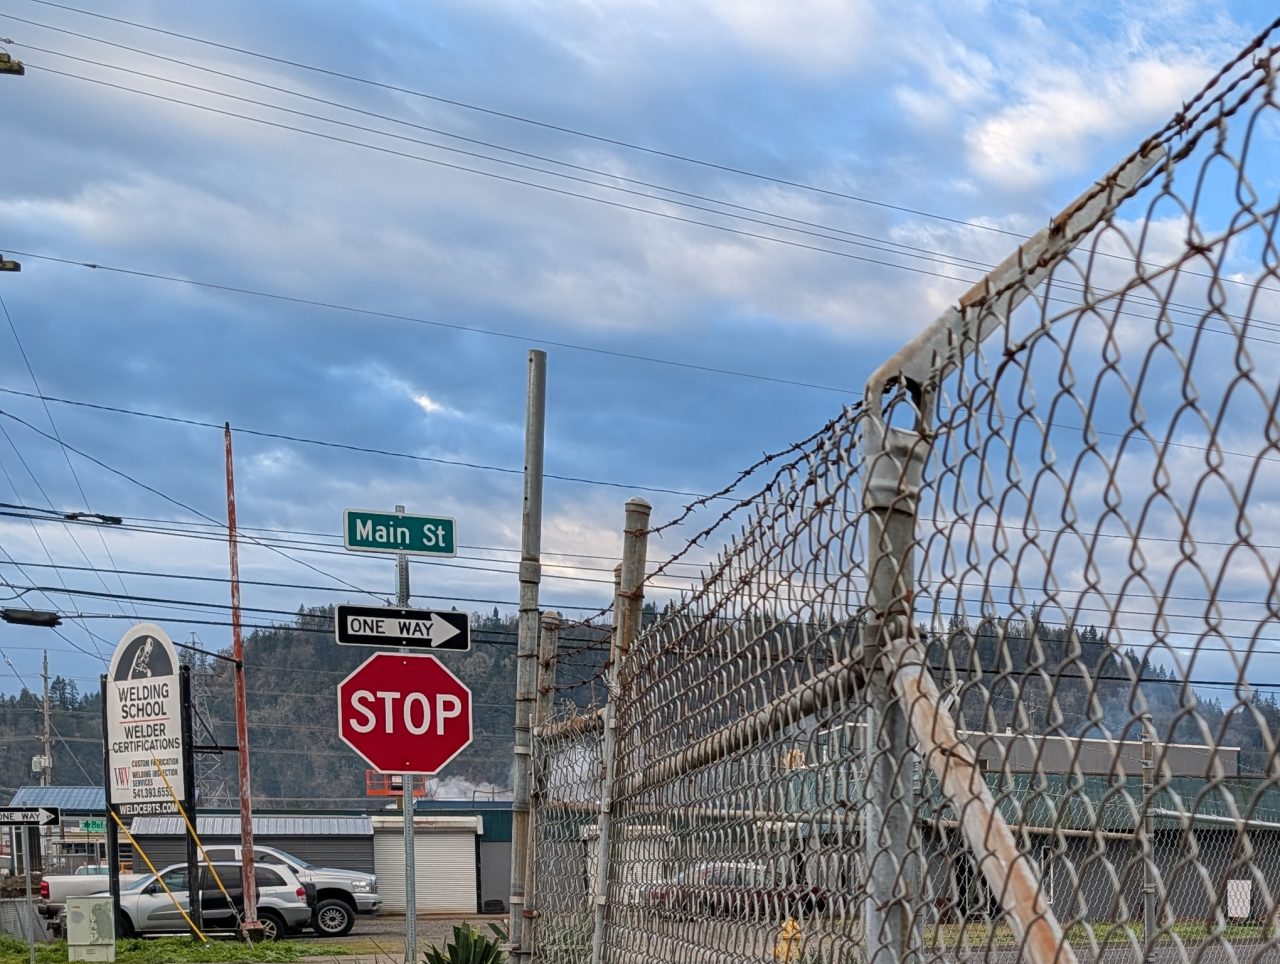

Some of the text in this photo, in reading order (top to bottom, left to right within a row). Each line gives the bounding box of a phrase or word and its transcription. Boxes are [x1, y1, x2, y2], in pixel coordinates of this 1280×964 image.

[356, 519, 446, 547] Main St
[350, 618, 434, 637] ONE WAY
[118, 683, 169, 702] WELDING
[121, 701, 167, 719] SCHOOL
[349, 690, 462, 735] STOP
[124, 723, 166, 740] WELDER
[112, 738, 180, 753] CERTIFICATIONS
[132, 758, 179, 768] CUSTOM FARICATION
[132, 769, 178, 779] WELDING INSECTION
[133, 779, 153, 787] SERVICES
[120, 802, 178, 815] WELDCERTS.COM
